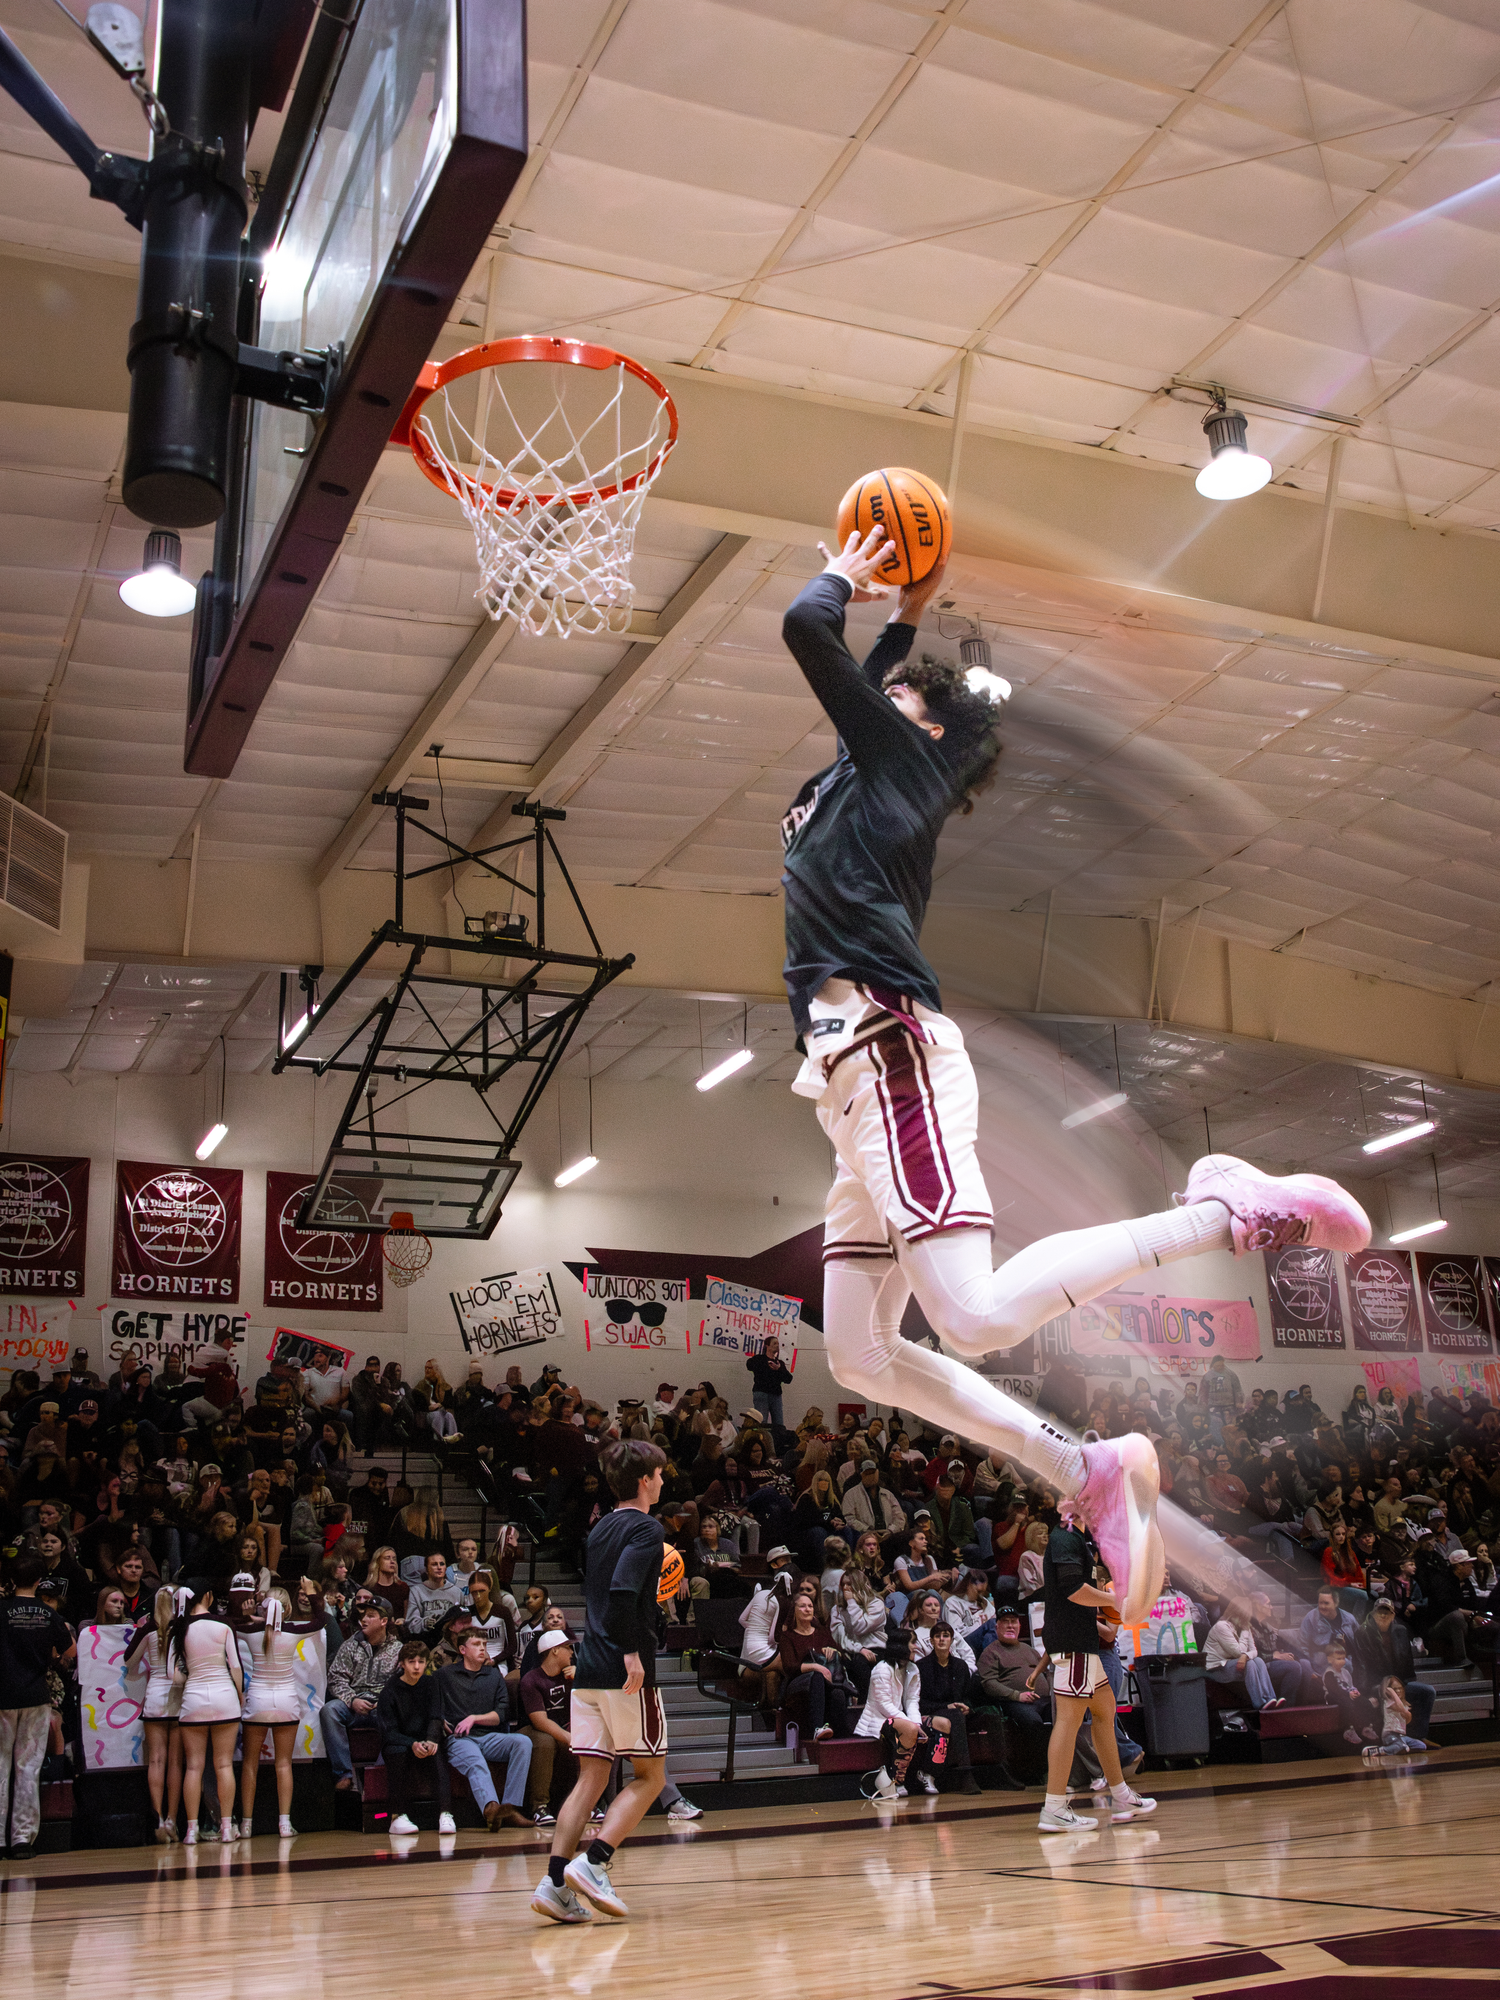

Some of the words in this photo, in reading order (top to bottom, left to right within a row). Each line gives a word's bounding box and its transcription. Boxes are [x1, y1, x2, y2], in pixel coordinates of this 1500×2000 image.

[909, 503, 933, 546] EVO
[38, 1208, 60, 1218] AAA
[139, 1223, 173, 1235] District
[193, 1227, 215, 1237] AAA
[119, 1273, 232, 1296] HORNETS
[270, 1280, 378, 1302] HORNETS
[588, 1275, 657, 1301] JUNIORS
[457, 1280, 512, 1313] HOOP
[709, 1281, 748, 1310] Class
[750, 1293, 768, 1312] of
[112, 1310, 173, 1341] GET
[183, 1312, 247, 1343] HYPE
[469, 1311, 557, 1355] HORNETS
[605, 1323, 666, 1346] SWAG
[1276, 1327, 1342, 1343] HORNETS
[1369, 1331, 1407, 1342] HORNETS
[713, 1327, 739, 1350] Paris
[1431, 1333, 1489, 1348] HORNETS
